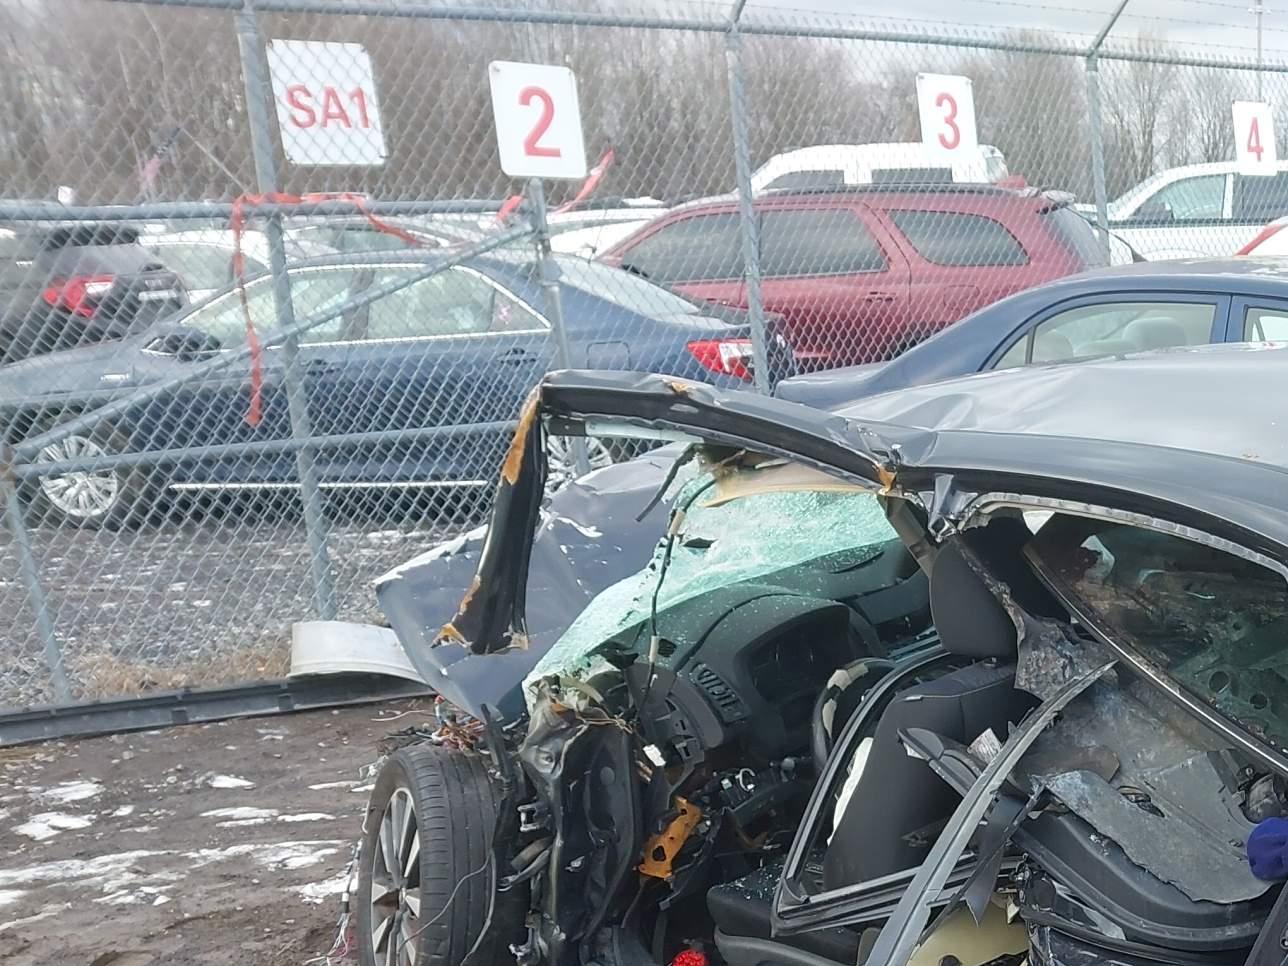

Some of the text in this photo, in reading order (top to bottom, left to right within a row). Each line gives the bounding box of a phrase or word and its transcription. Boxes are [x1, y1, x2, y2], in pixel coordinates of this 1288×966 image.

[285, 84, 370, 129] SA1
[518, 85, 562, 158] 2
[935, 92, 961, 150] 3
[1246, 116, 1265, 162] 4
